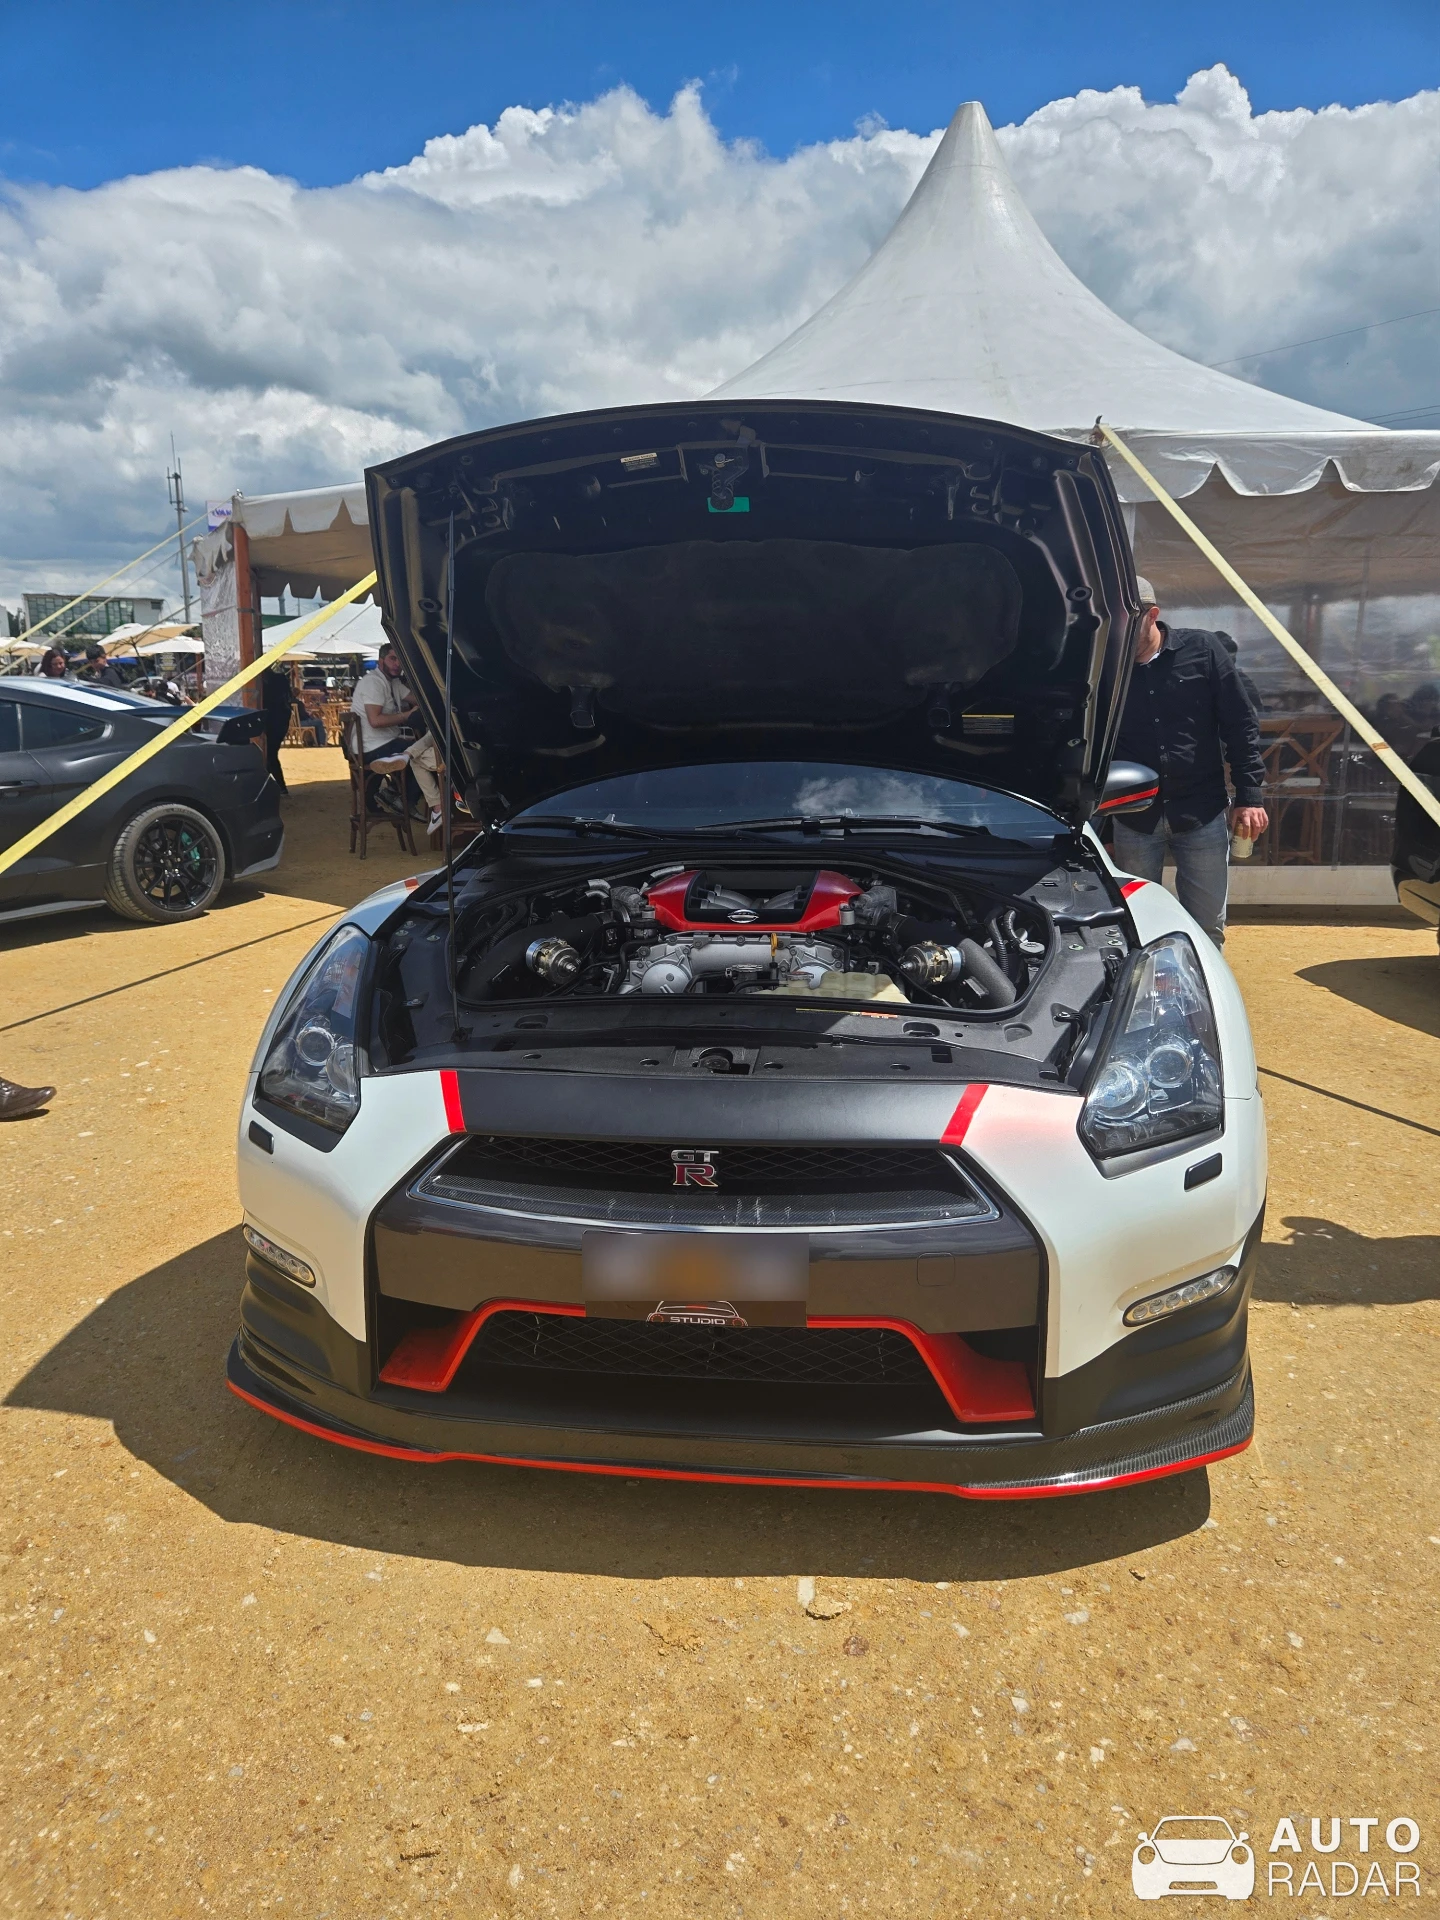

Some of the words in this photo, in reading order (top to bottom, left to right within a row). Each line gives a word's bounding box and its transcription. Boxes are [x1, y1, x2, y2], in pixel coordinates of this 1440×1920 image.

[671, 1149, 719, 1162] GT
[672, 1163, 719, 1187] R
[670, 1316, 726, 1325] STUDIO
